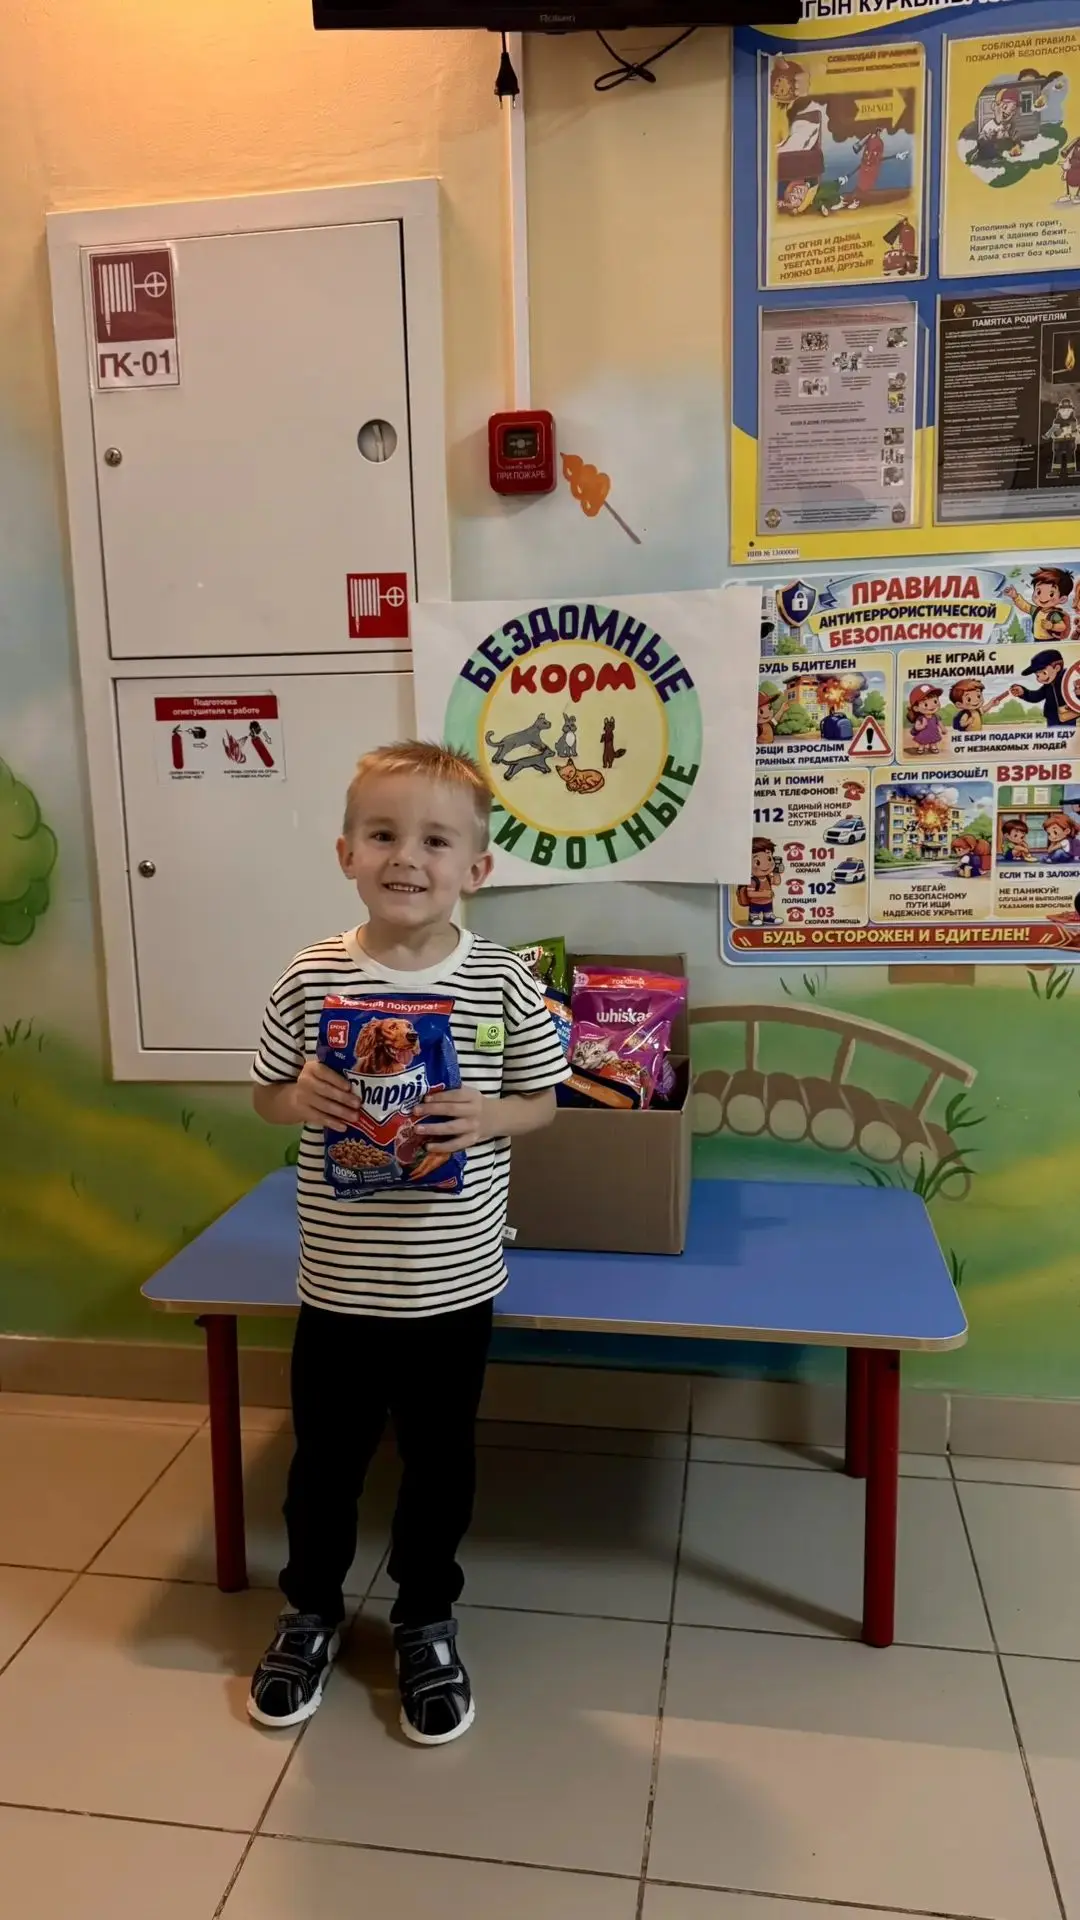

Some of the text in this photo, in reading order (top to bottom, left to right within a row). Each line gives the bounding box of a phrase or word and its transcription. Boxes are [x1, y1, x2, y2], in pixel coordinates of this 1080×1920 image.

[981, 35, 1076, 51] СОБЛЮДАЙ ПРАВИЛА
[966, 51, 1015, 63] ПОЖАРНОЙ
[970, 222, 1017, 233] Тополиный
[1019, 222, 1033, 230] пух
[1007, 231, 1039, 240] зданию
[785, 233, 861, 252] ОТ ОГНЯ И ДЫМА
[777, 247, 836, 262] СПРЯТАТЬСЯ
[783, 256, 822, 270] УБЕГАТЬ
[837, 251, 864, 262] ДОМА
[969, 254, 976, 262] А
[977, 254, 1000, 262] дома
[1002, 251, 1025, 259] стоят
[1027, 248, 1043, 257] без
[780, 269, 813, 280] НУЖНО
[814, 264, 835, 273] ВАМ,
[972, 312, 1067, 327] ПАМЯТКА РОДИТЕЛЯМ
[851, 575, 980, 605] ПРАВИЛА
[818, 603, 997, 629] АНТИТЕРРОРИСТИЧЕСКОЙ
[828, 622, 984, 649] БЕЗОПАСНОСТИ
[459, 604, 694, 704] БЕЗДОМНЫЕ
[926, 650, 997, 664] НЕ ИГРАЙ С
[792, 659, 857, 672] БДИТЕЛЕН
[908, 664, 1014, 679] НЕЗНАКОМЦАМИ
[964, 734, 986, 742] БЕРИ
[989, 731, 1032, 741] ПОДАРКИ
[1057, 730, 1076, 739] ЕДУ
[787, 743, 845, 753] ВЗРОСЛЫМ
[954, 740, 1067, 753] ОТ НЕЗНАКОМЫХ ЛЮДЕЙ
[798, 755, 850, 765] ПРЕДМЕТАХ
[891, 764, 1072, 782] ЕСЛИ ПРОИЗОШЁЛ ВЗРЫВ
[774, 777, 781, 785] И
[785, 775, 824, 785] ПОМНИ
[780, 787, 838, 797] ТЕЛЕФОНОВ!
[492, 755, 699, 869] ИВОТНЫЕ
[788, 801, 852, 811] ЕДИНЫЙ НОМЕР
[753, 807, 784, 823] 112
[788, 811, 842, 819] ЭКСТРЕННЫХ
[809, 847, 835, 860] 101
[808, 882, 836, 895] 102
[911, 884, 946, 893] УБЕГАЙ!
[1015, 886, 1059, 894] ПАНИКУЙ!
[782, 897, 817, 905] ПОЛИЦИЯ
[903, 892, 967, 901] БЕЗОПАСНОМУ
[905, 901, 951, 909] ПУТИ ИЩИ
[810, 907, 835, 918] 103
[933, 909, 973, 917] УКРЫТИЕ
[763, 927, 1030, 945] БУДЬ ОСТОРОЖЕН И БДИТЕЛЕН!
[332, 1164, 357, 1178] 100%
